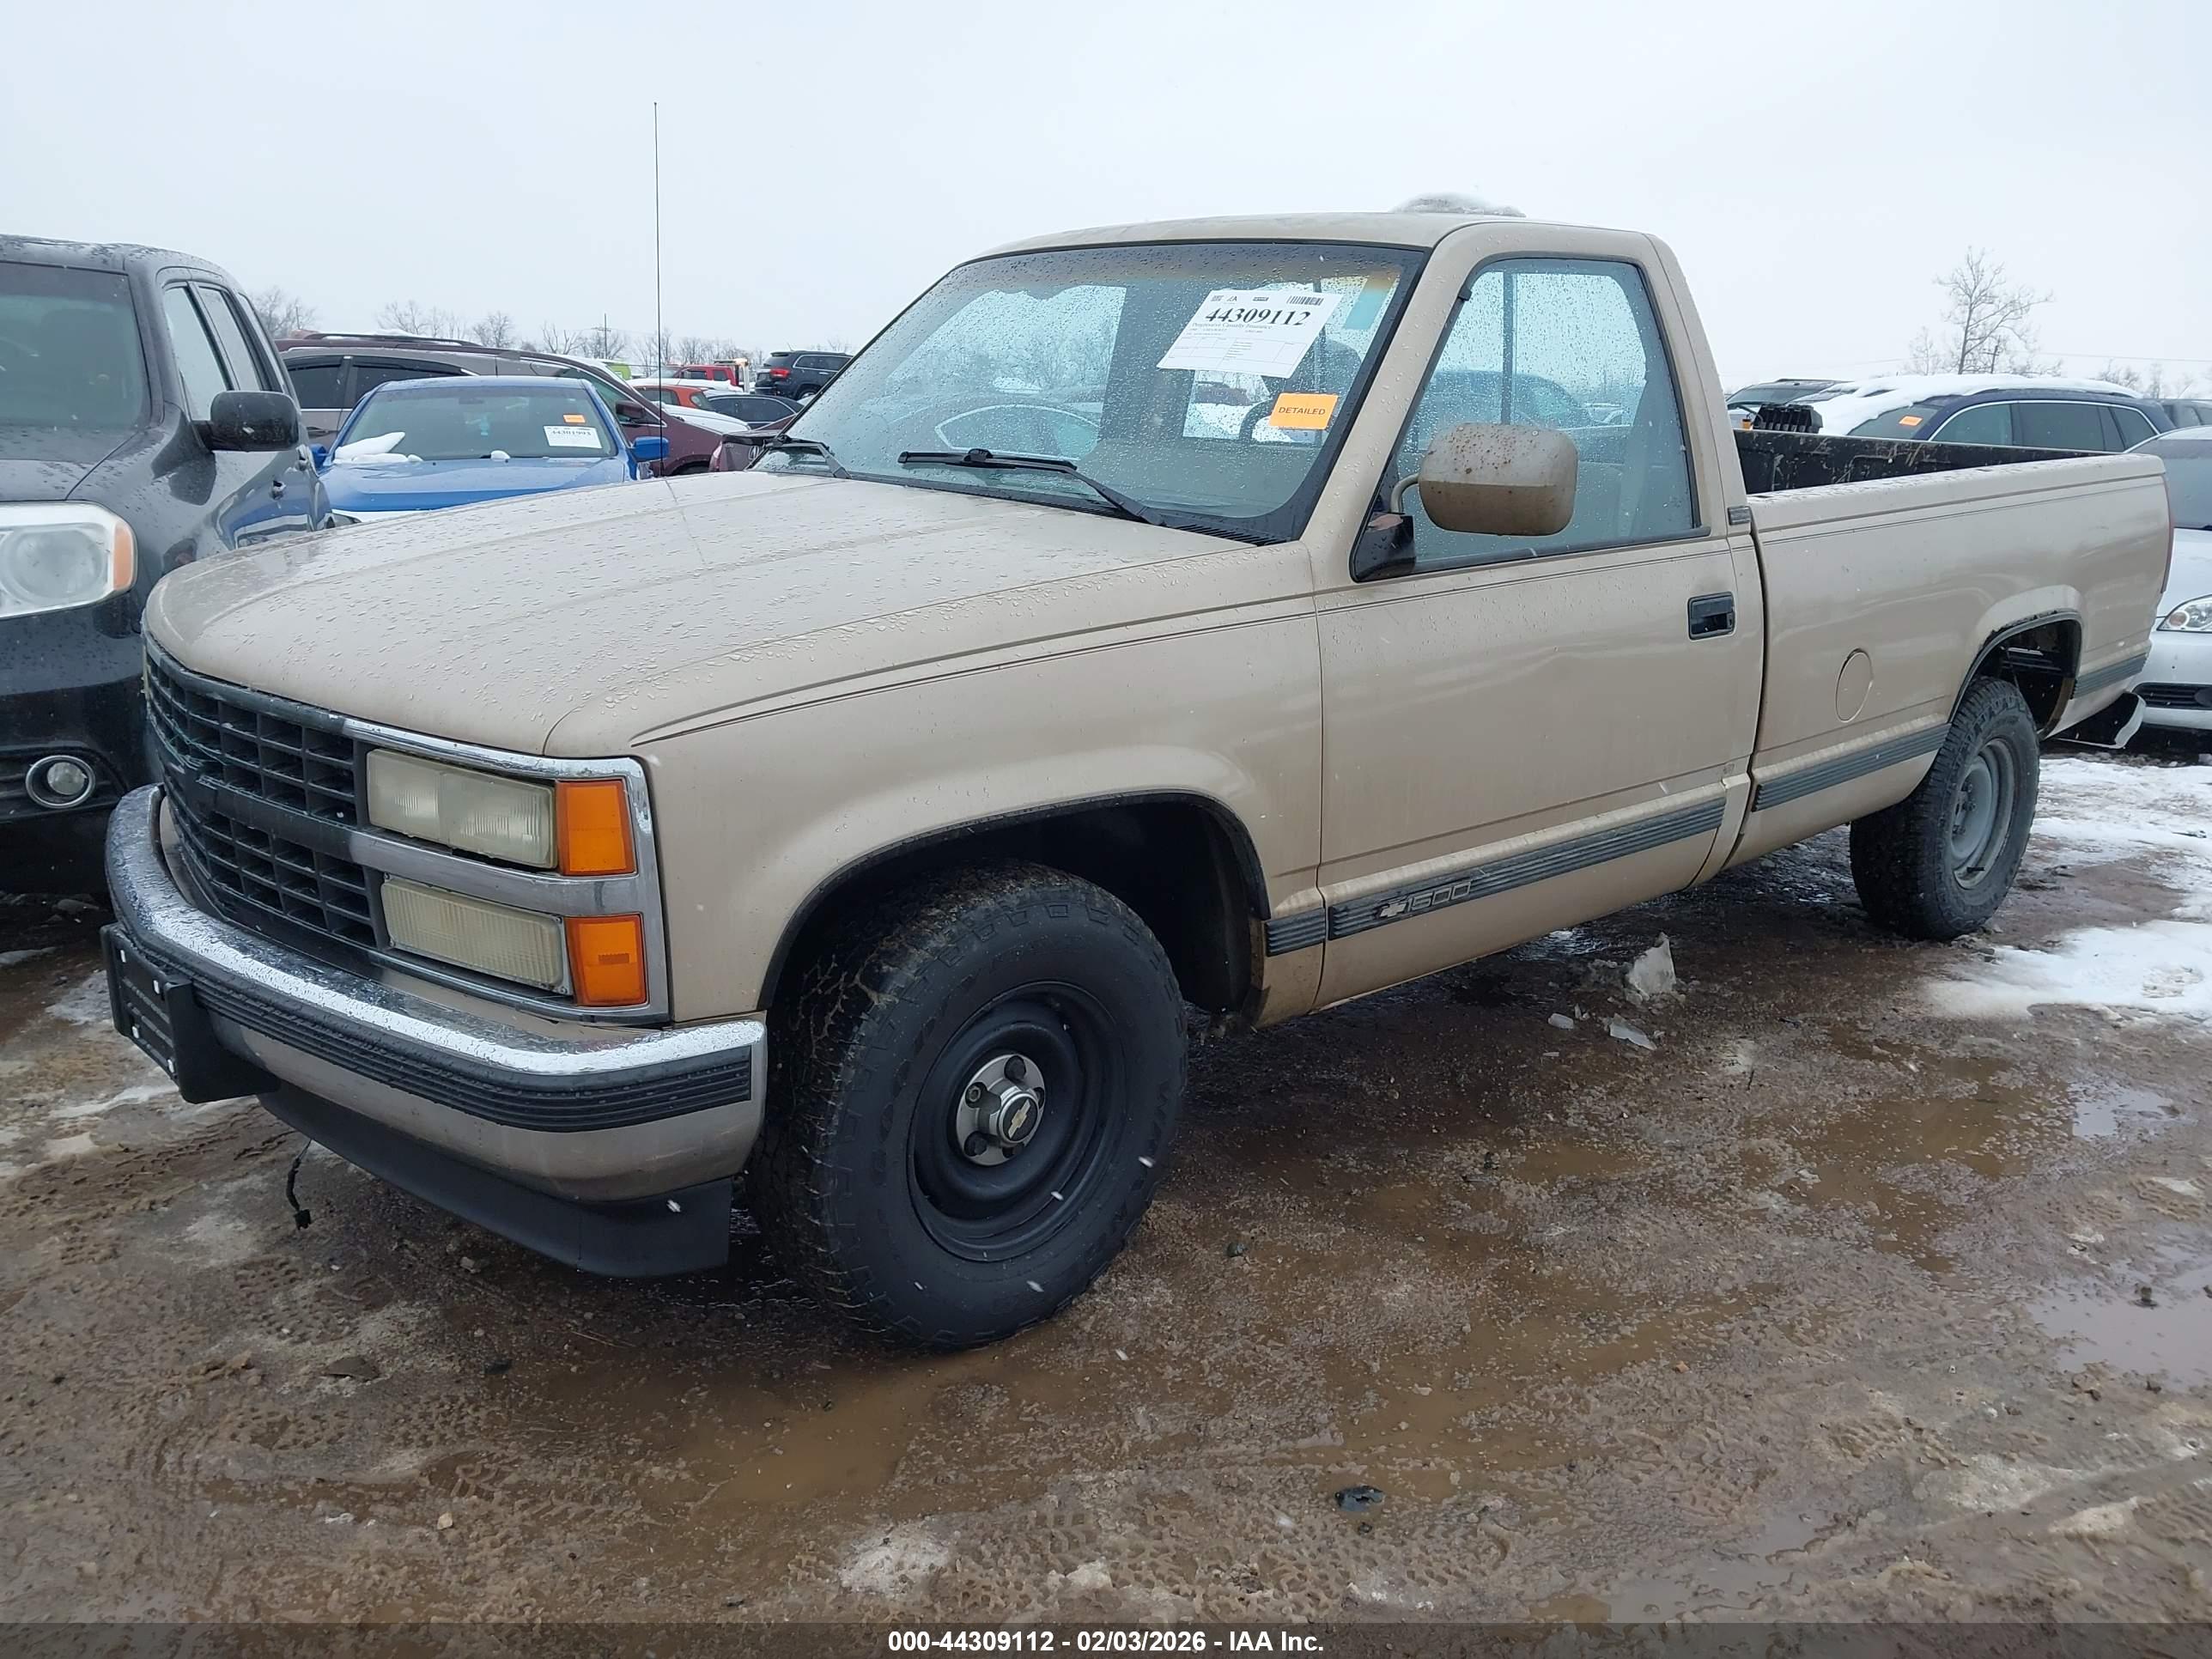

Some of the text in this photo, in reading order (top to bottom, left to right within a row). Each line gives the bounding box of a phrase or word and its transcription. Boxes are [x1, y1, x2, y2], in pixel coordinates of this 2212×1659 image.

[1206, 307, 1311, 326] 44309112
[1278, 406, 1326, 416] DETAILED
[1407, 881, 1472, 912] 1500
